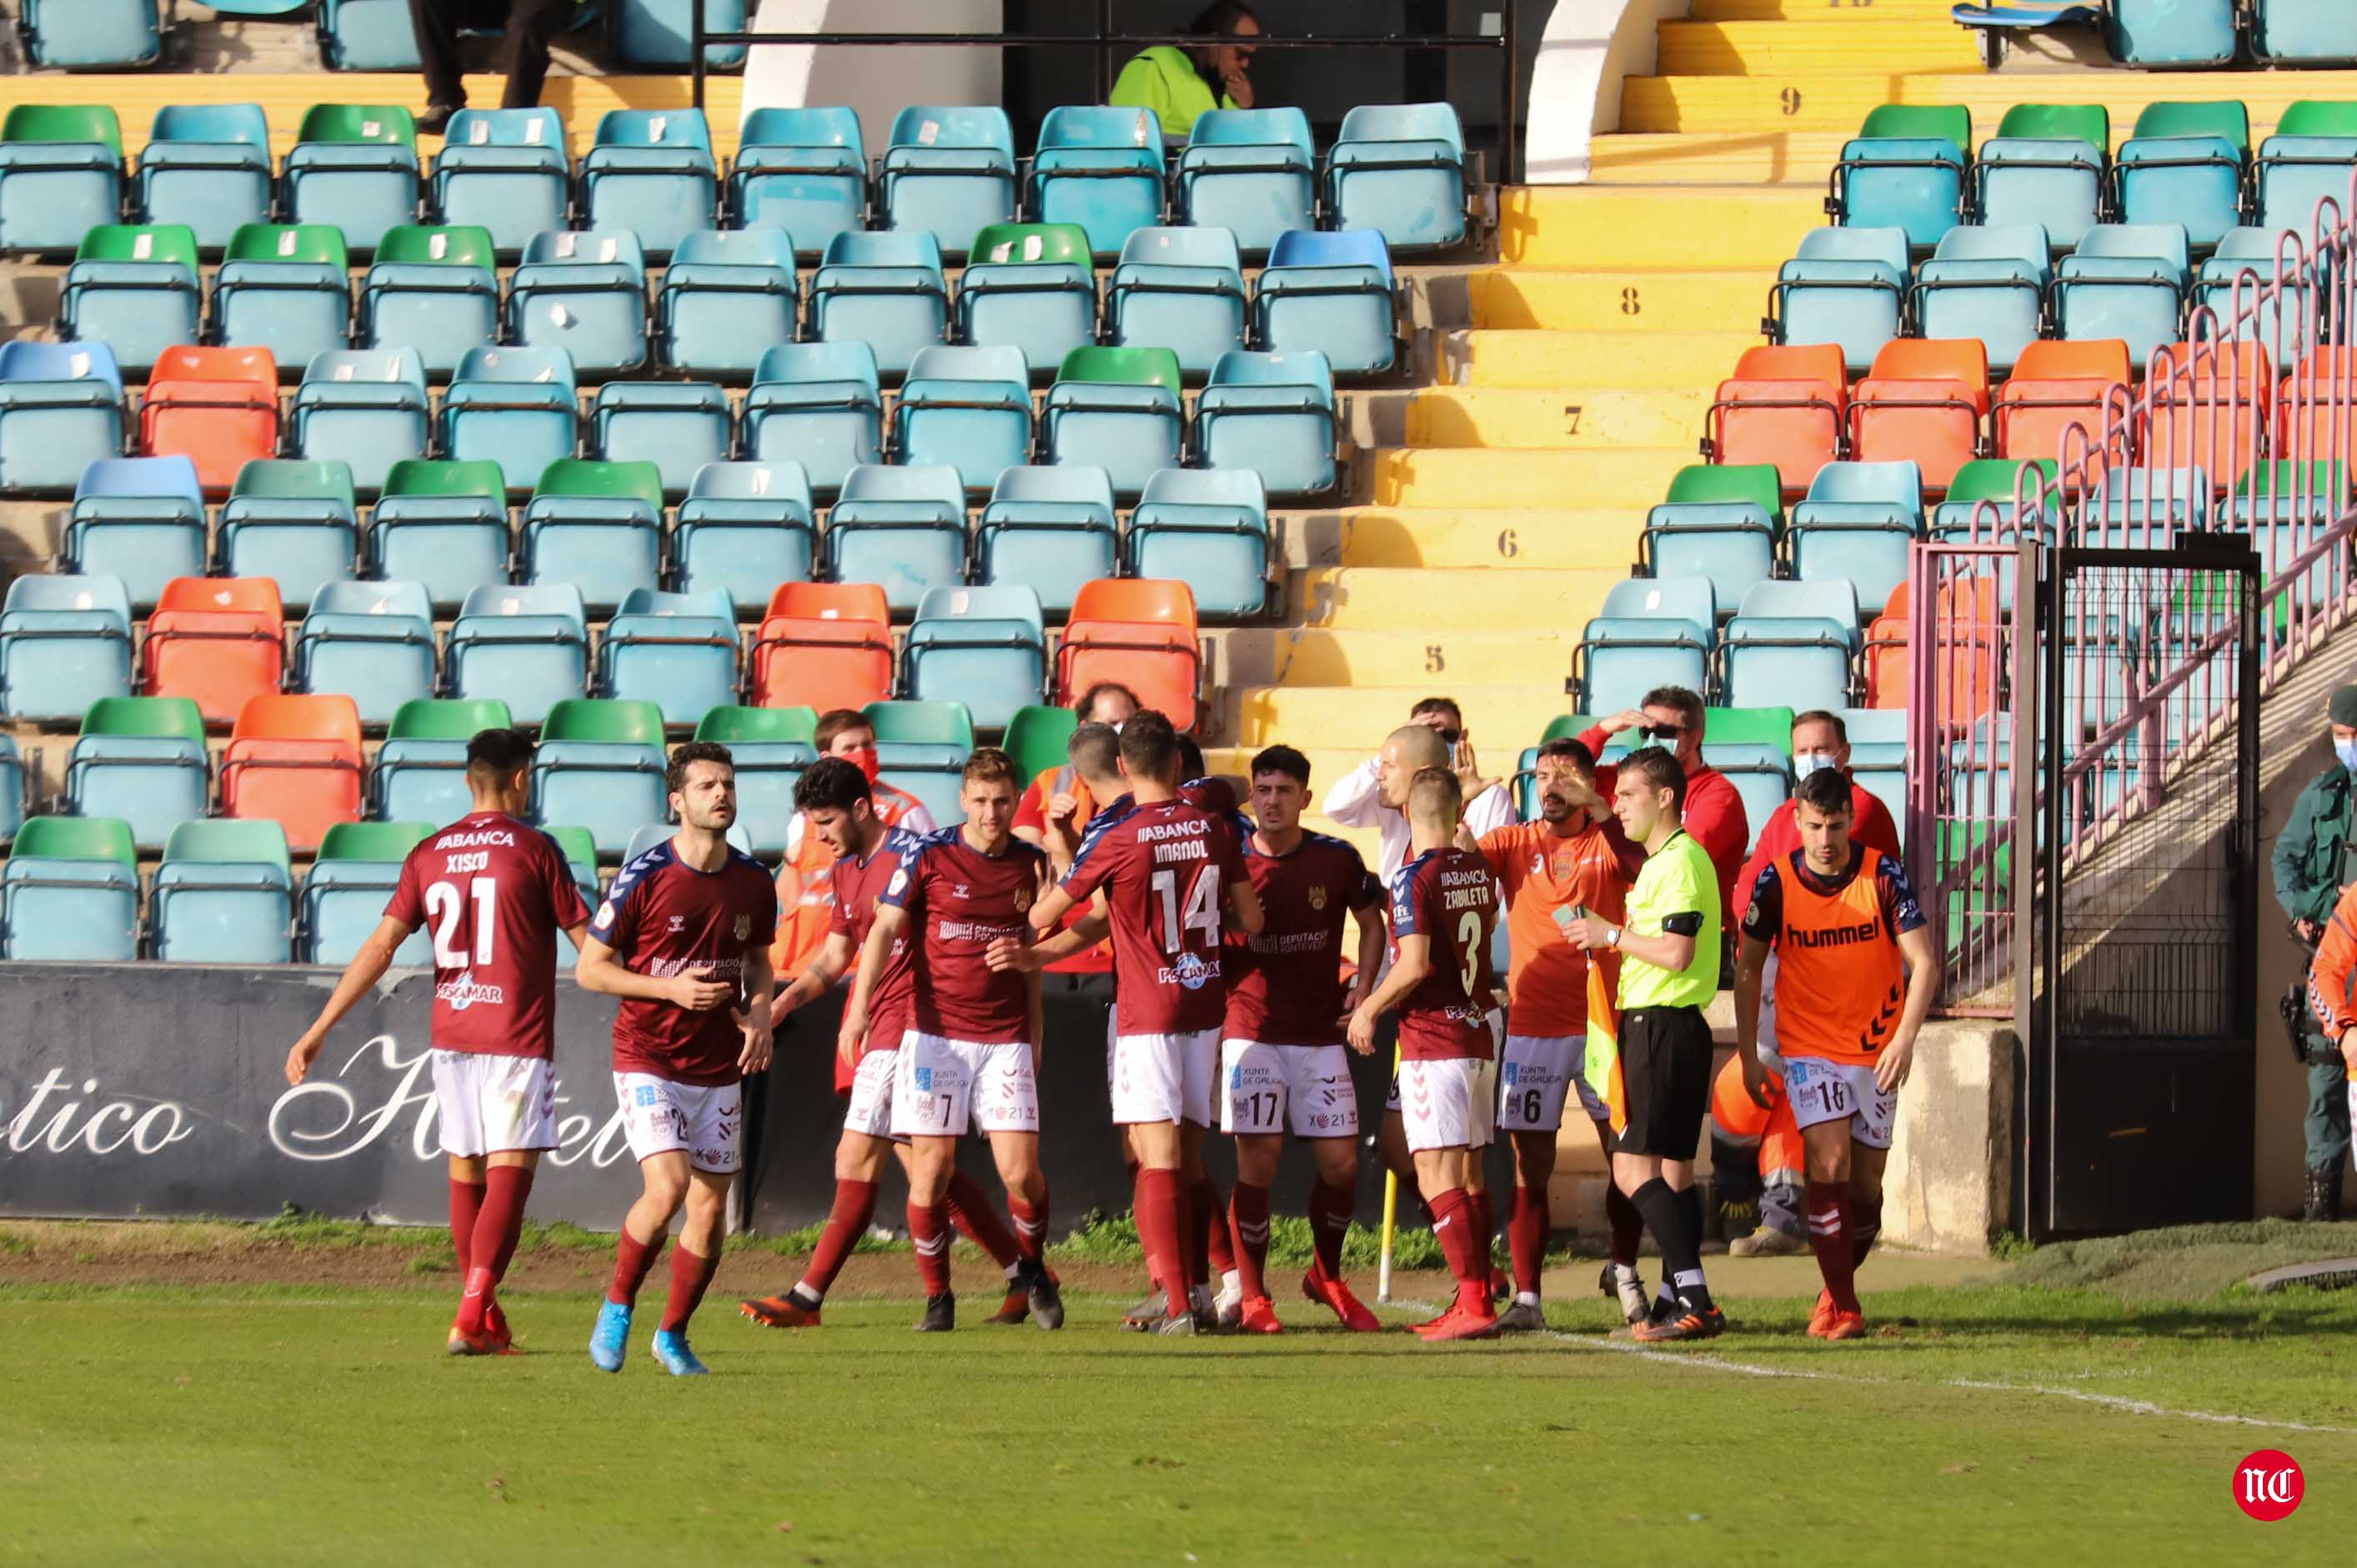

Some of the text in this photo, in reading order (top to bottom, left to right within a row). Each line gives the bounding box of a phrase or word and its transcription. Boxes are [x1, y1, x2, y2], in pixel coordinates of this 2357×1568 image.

[1780, 87, 1801, 115] 9
[1621, 287, 1641, 315] 8
[1565, 406, 1582, 435] 7
[1498, 529, 1518, 558] 6
[1425, 644, 1445, 674] 5
[445, 851, 489, 874] XISCO
[1154, 839, 1208, 864] IMANOL
[425, 877, 495, 969] 21
[1151, 864, 1221, 954] 14
[1788, 915, 1878, 948] hummel
[1458, 910, 1482, 997] 3
[0, 1068, 194, 1154] tico
[941, 1094, 952, 1128] 7
[1250, 1092, 1278, 1126] 17
[1524, 1089, 1542, 1124] 6
